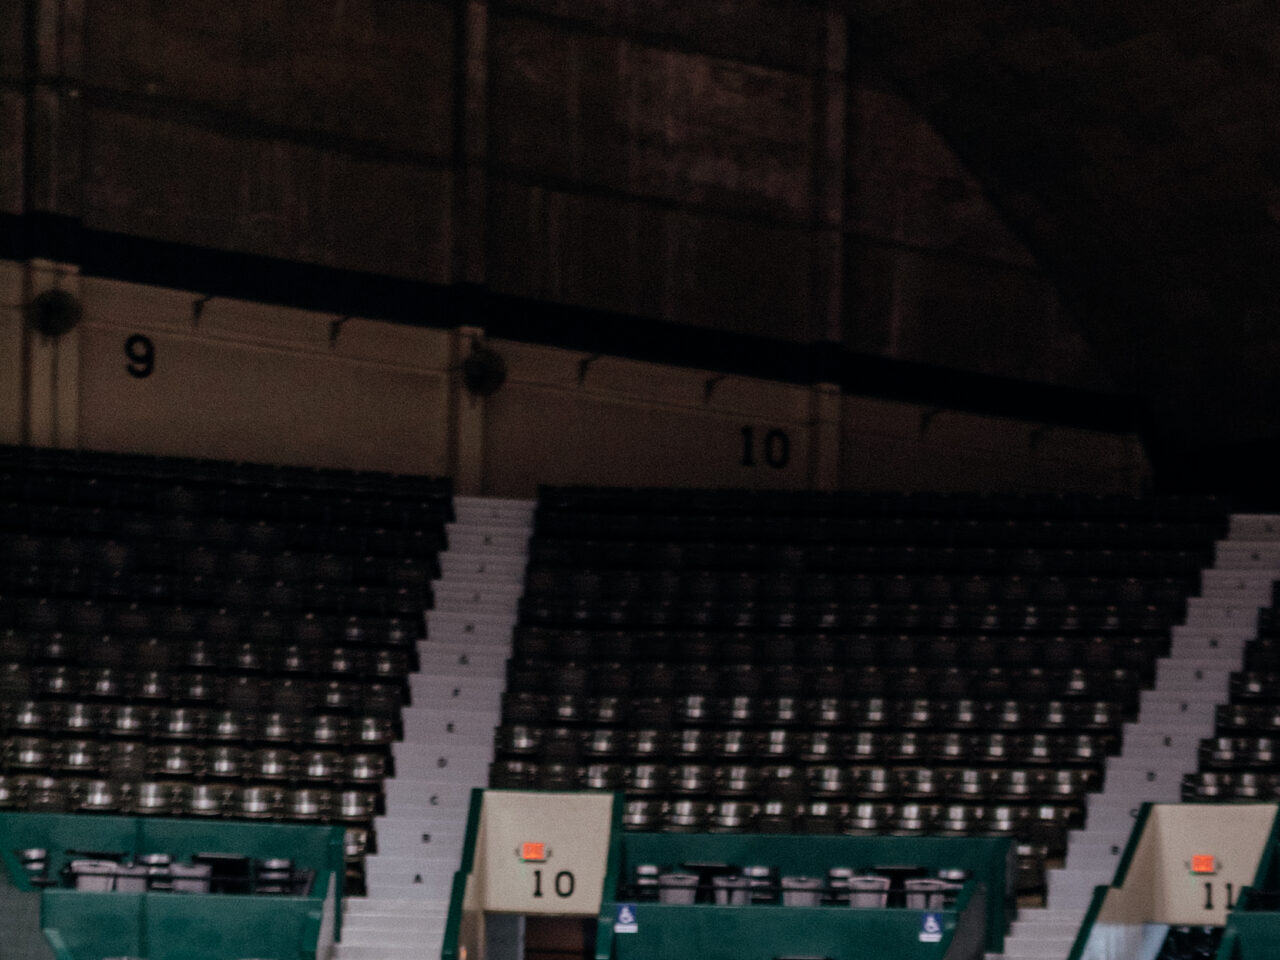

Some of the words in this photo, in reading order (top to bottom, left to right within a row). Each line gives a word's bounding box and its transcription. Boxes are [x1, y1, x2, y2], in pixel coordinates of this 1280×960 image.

[125, 334, 154, 378] 9
[741, 427, 788, 468] 10
[534, 870, 575, 898] 10
[1205, 882, 1235, 910] 11
